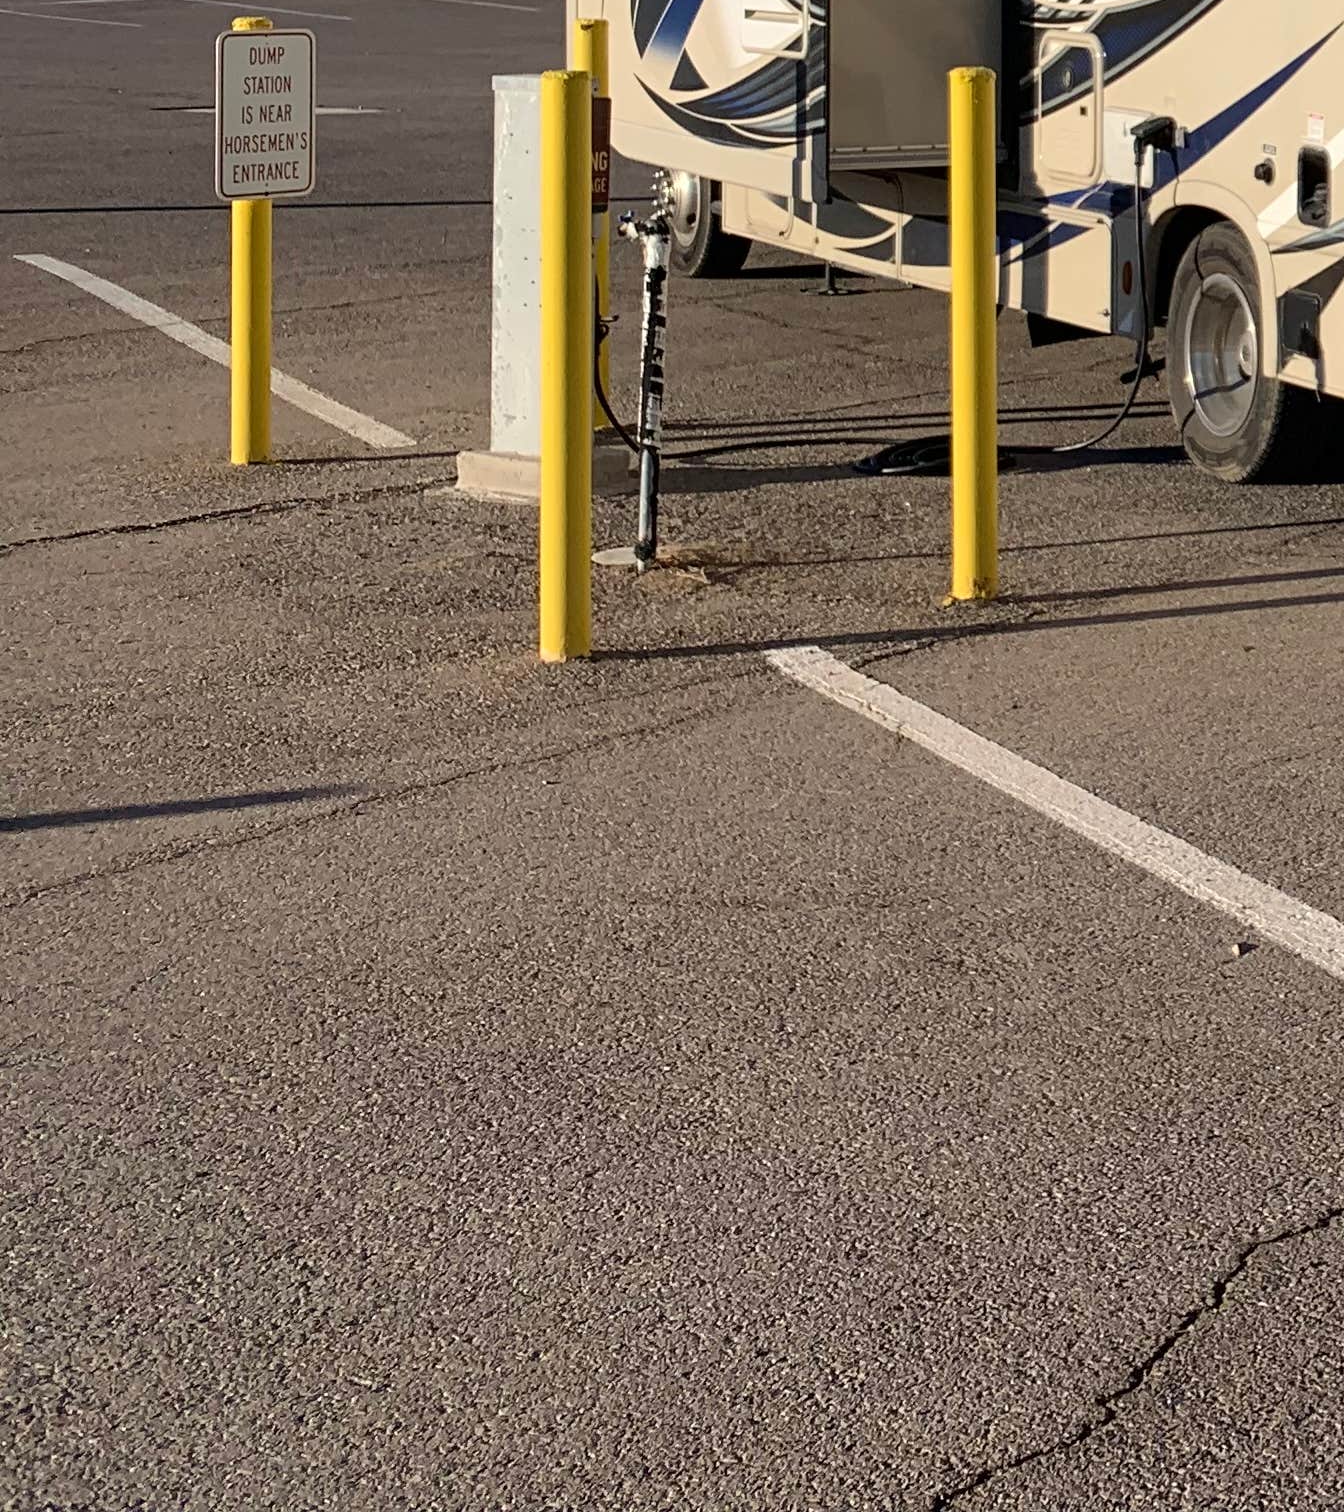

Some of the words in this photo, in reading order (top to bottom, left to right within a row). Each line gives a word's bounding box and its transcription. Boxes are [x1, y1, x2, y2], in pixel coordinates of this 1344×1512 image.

[249, 46, 285, 65] DUMP
[243, 75, 292, 95] STATION
[241, 105, 253, 124] IS
[259, 104, 292, 123] NEAR
[224, 132, 308, 154] HORSEMEN'S
[233, 161, 300, 183] ENTRANCE
